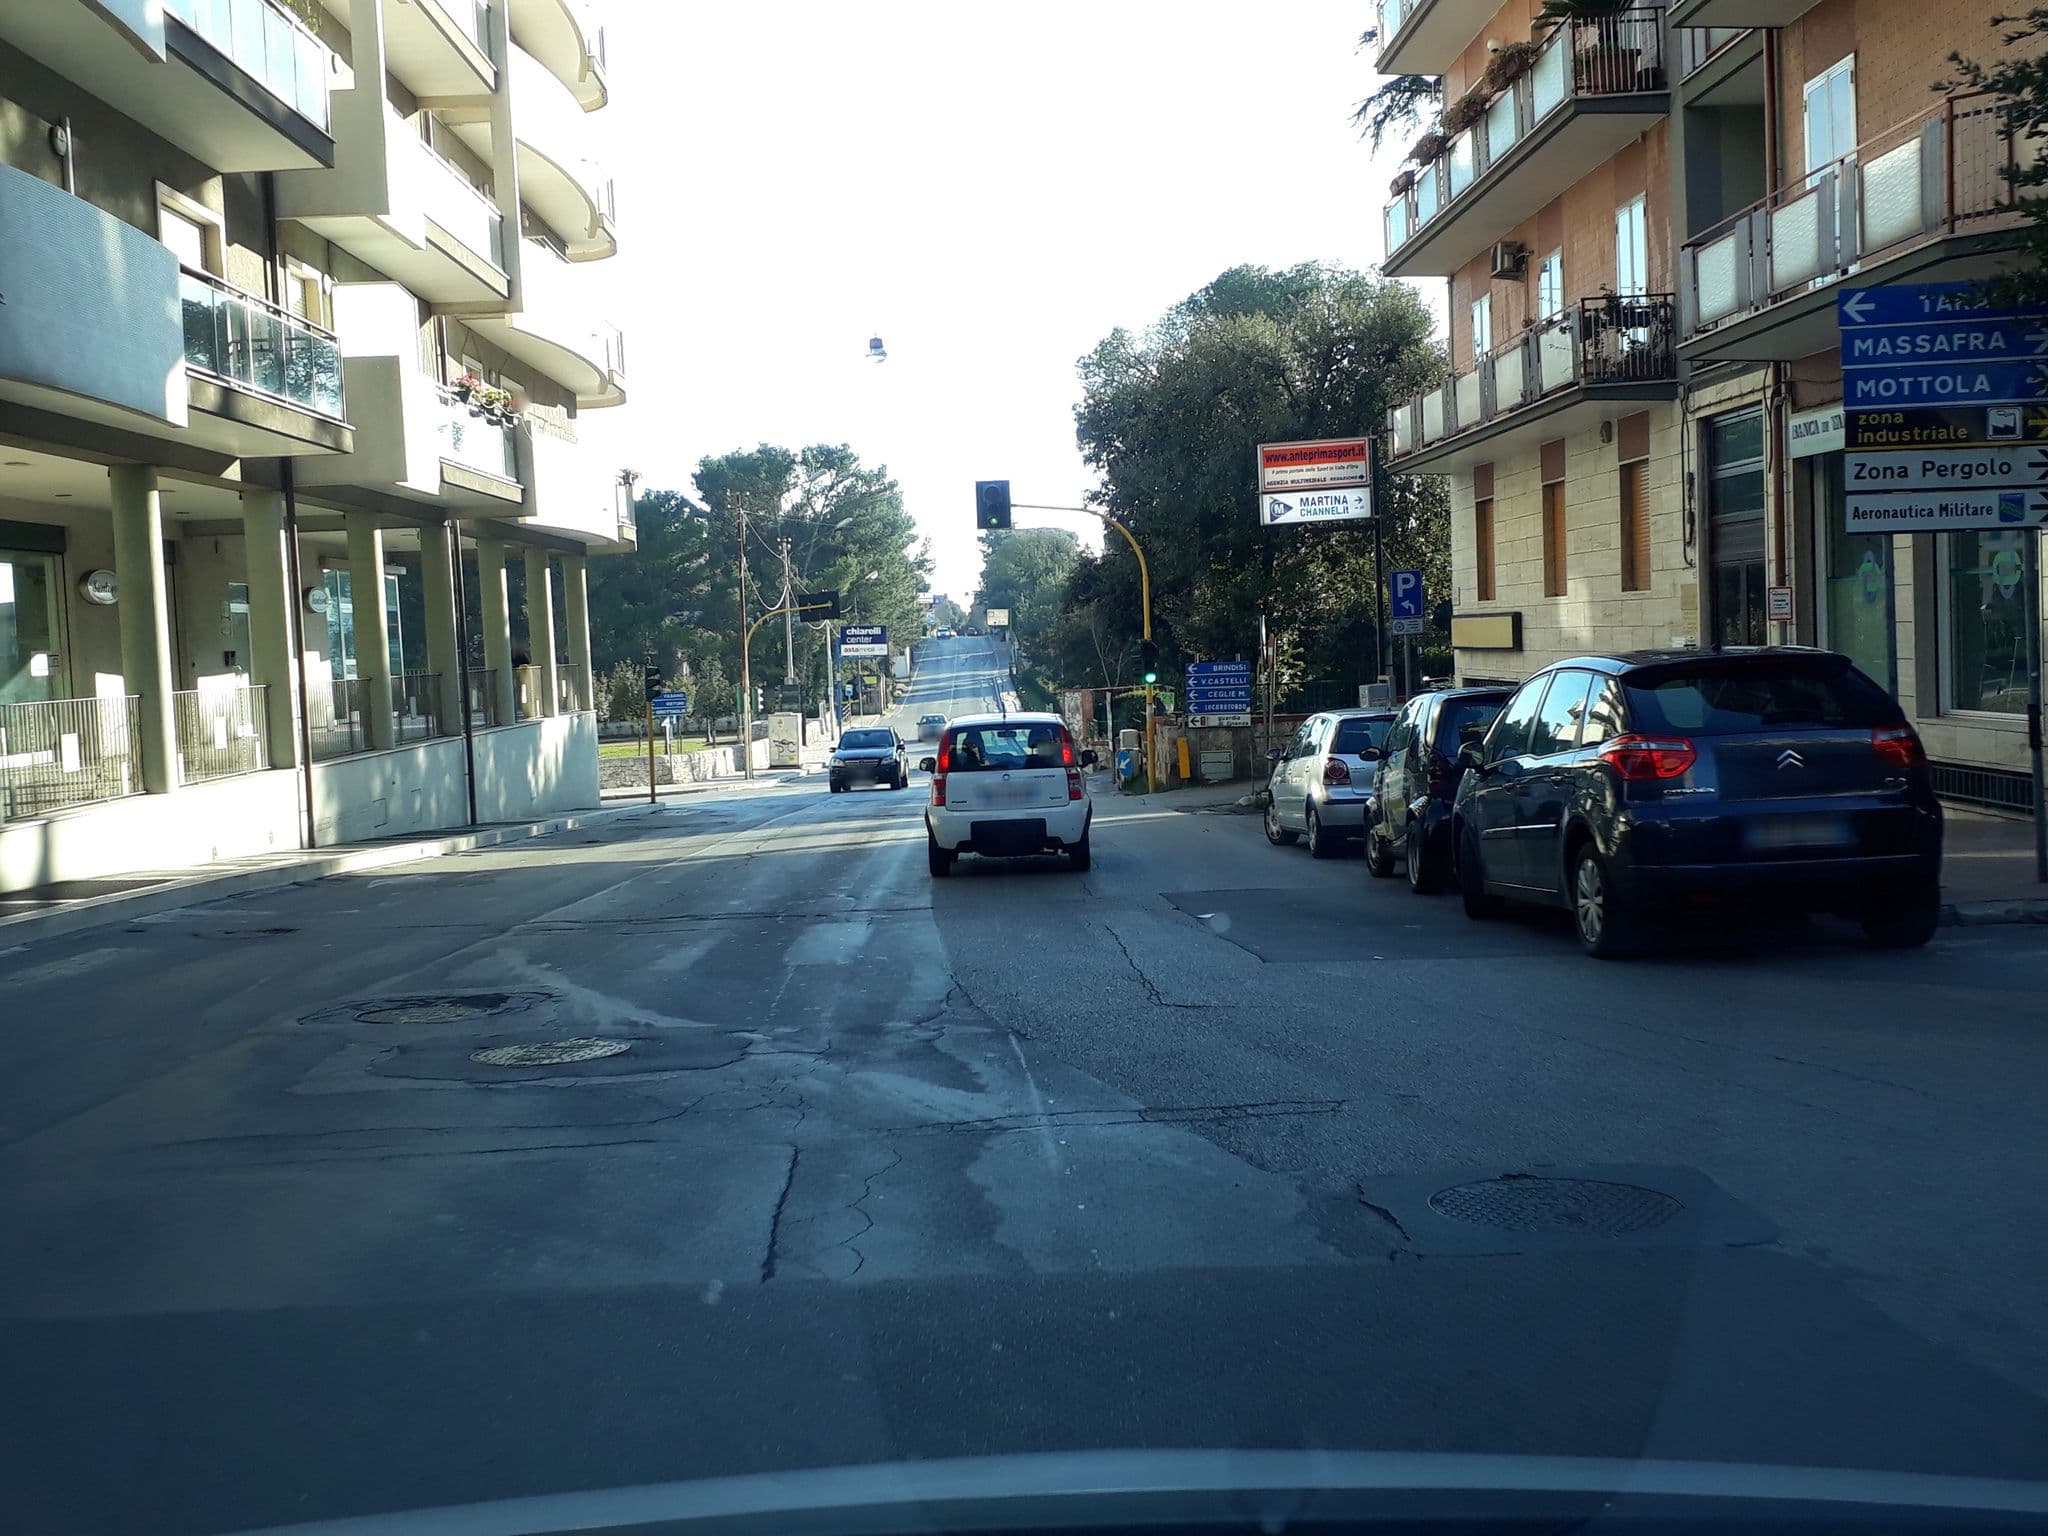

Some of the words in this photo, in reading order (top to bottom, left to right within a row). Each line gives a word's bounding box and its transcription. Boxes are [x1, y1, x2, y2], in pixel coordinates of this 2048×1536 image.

[1853, 331, 2007, 357] MASSAFRA
[1856, 374, 1991, 398] MOTTOLA
[1857, 411, 1904, 425] zona
[1791, 419, 1820, 440] BANCA
[1857, 425, 1968, 444] industriale
[1264, 445, 1365, 463] www.anteprimasport.it
[1853, 461, 1909, 480] Zona
[1921, 458, 2013, 483] Pergolo
[1267, 479, 1288, 487] AGENZIA
[1300, 495, 1348, 507] MARTINA
[1852, 501, 1934, 520] Aeronautica
[1939, 498, 1993, 518] Militare
[1300, 506, 1349, 517] CHANNEL.it
[1396, 573, 1416, 598] P
[846, 626, 882, 636] chiarelli
[1212, 664, 1247, 672] BRINDISI
[1200, 677, 1247, 685] V.CASTELLI
[1207, 690, 1236, 698] CEGLIE
